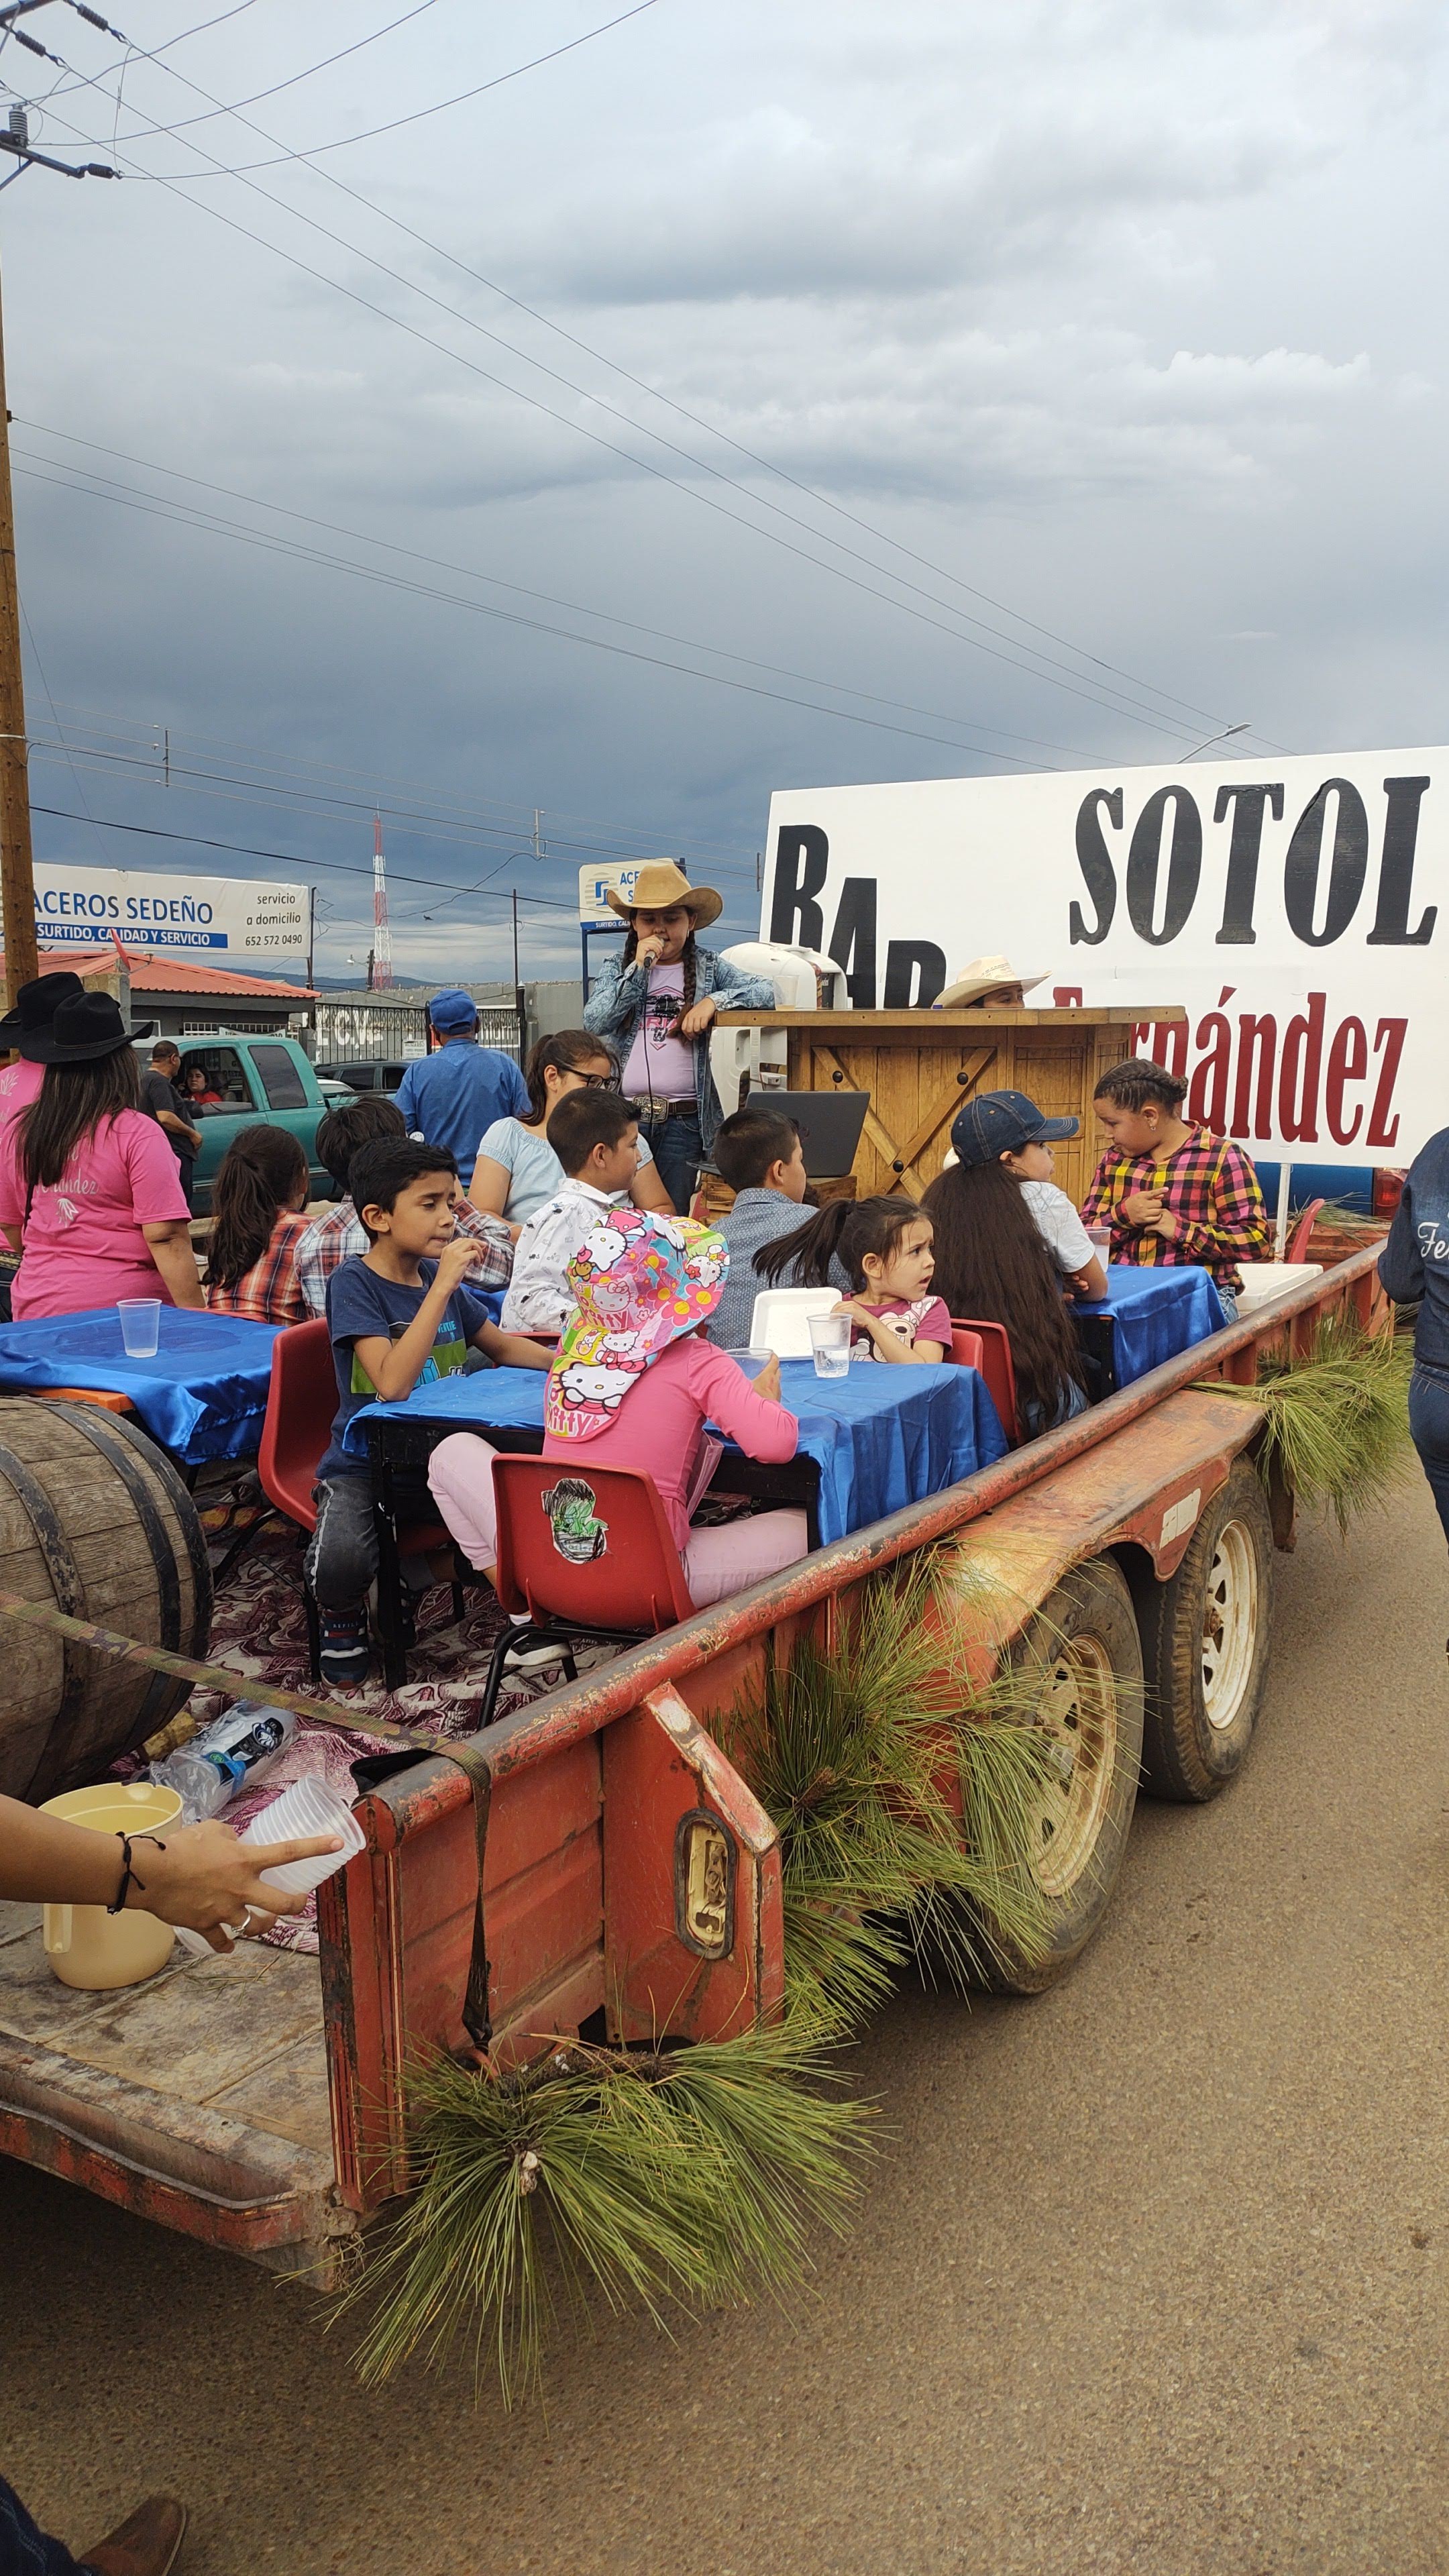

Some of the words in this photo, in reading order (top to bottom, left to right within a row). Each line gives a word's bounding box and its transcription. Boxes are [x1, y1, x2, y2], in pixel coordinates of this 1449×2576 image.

[1070, 776, 1438, 947] SOTOL
[257, 892, 296, 904] servicio
[127, 894, 213, 924] SEDEÑO
[246, 916, 253, 925] a
[256, 912, 301, 925] domicilio
[37, 923, 95, 942] SURTIDO,
[151, 930, 158, 943] Y
[160, 930, 210, 946] SERVICIO
[246, 936, 261, 946] 652
[264, 935, 279, 945] 572
[282, 934, 303, 945] 0490
